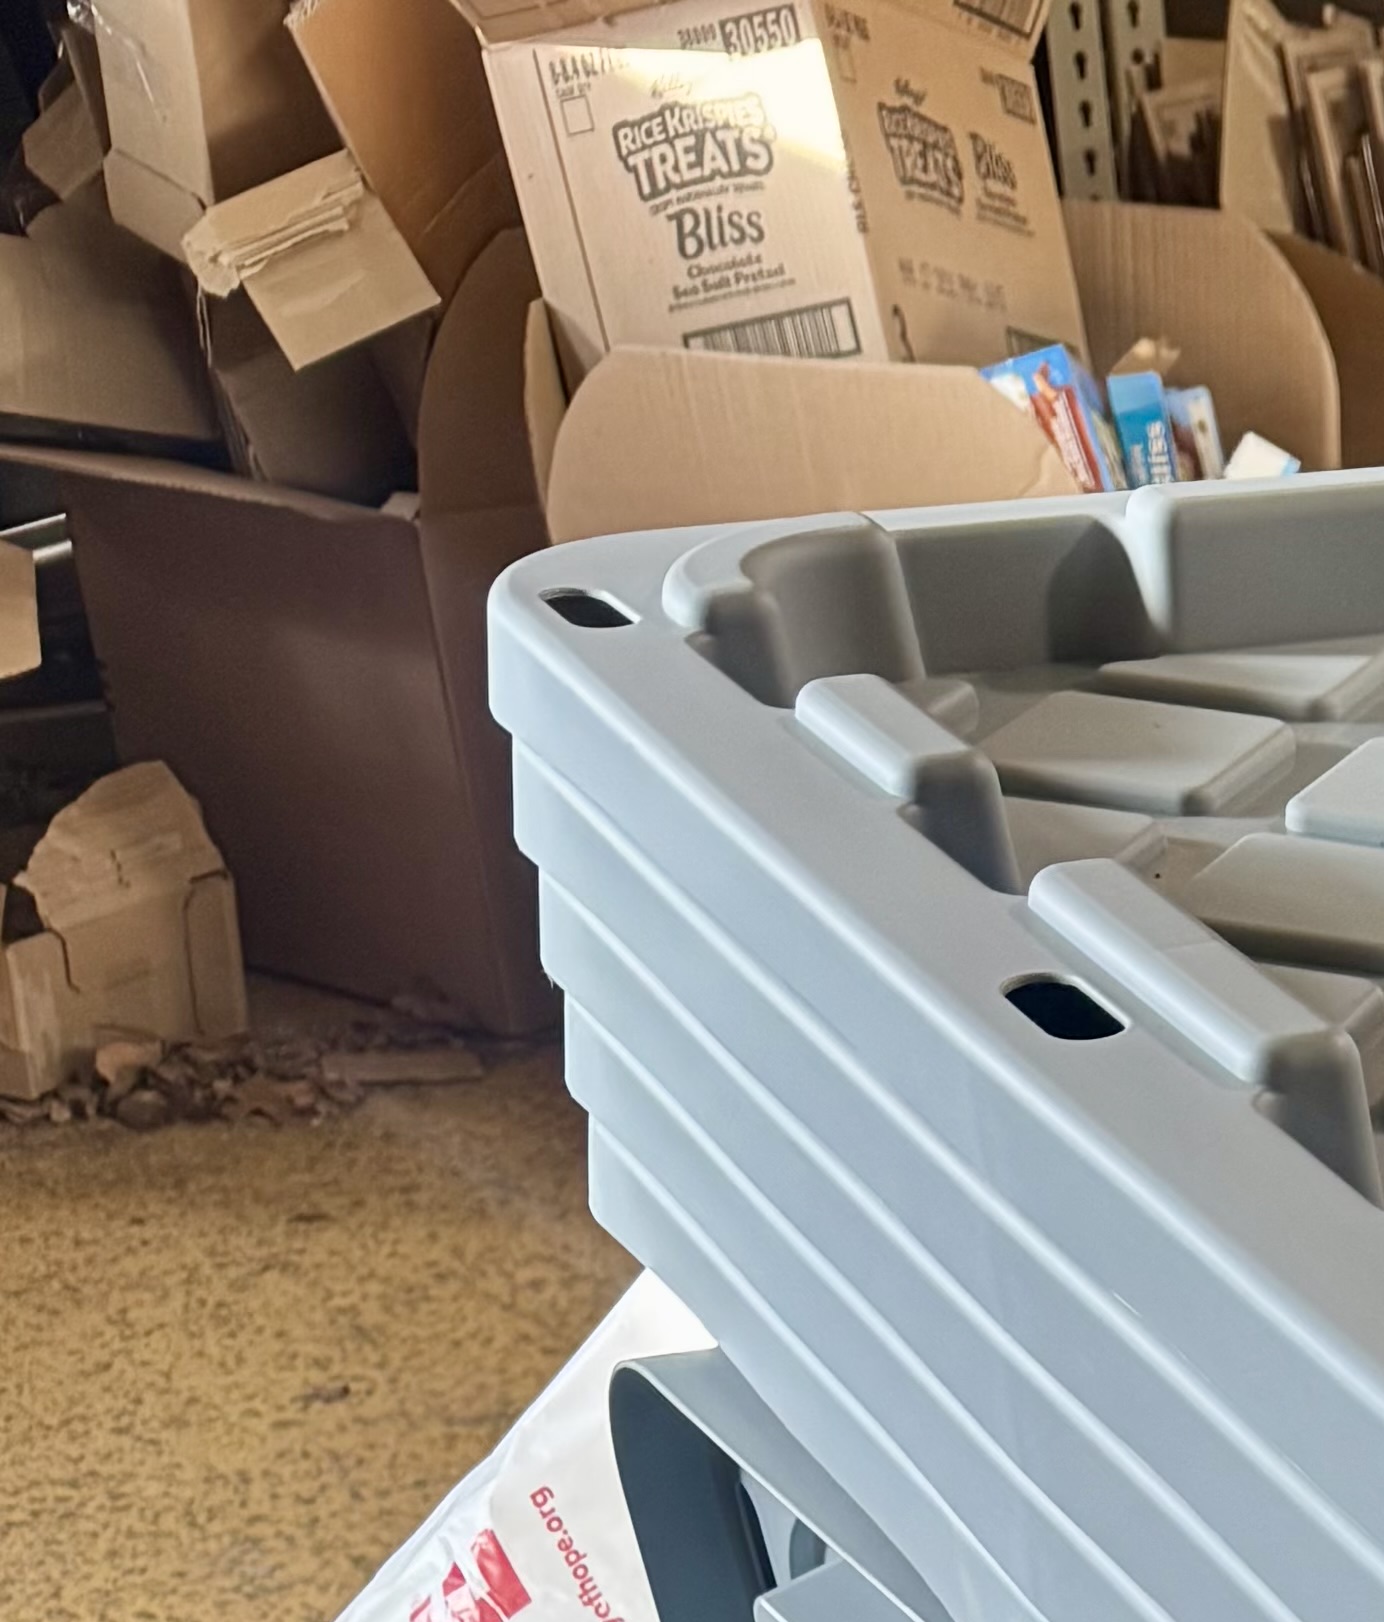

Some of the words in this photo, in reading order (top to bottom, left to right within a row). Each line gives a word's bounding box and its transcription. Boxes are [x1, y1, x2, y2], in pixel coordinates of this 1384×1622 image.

[616, 116, 664, 156] RICE
[627, 125, 774, 200] TREATS
[666, 203, 766, 260] Bliss
